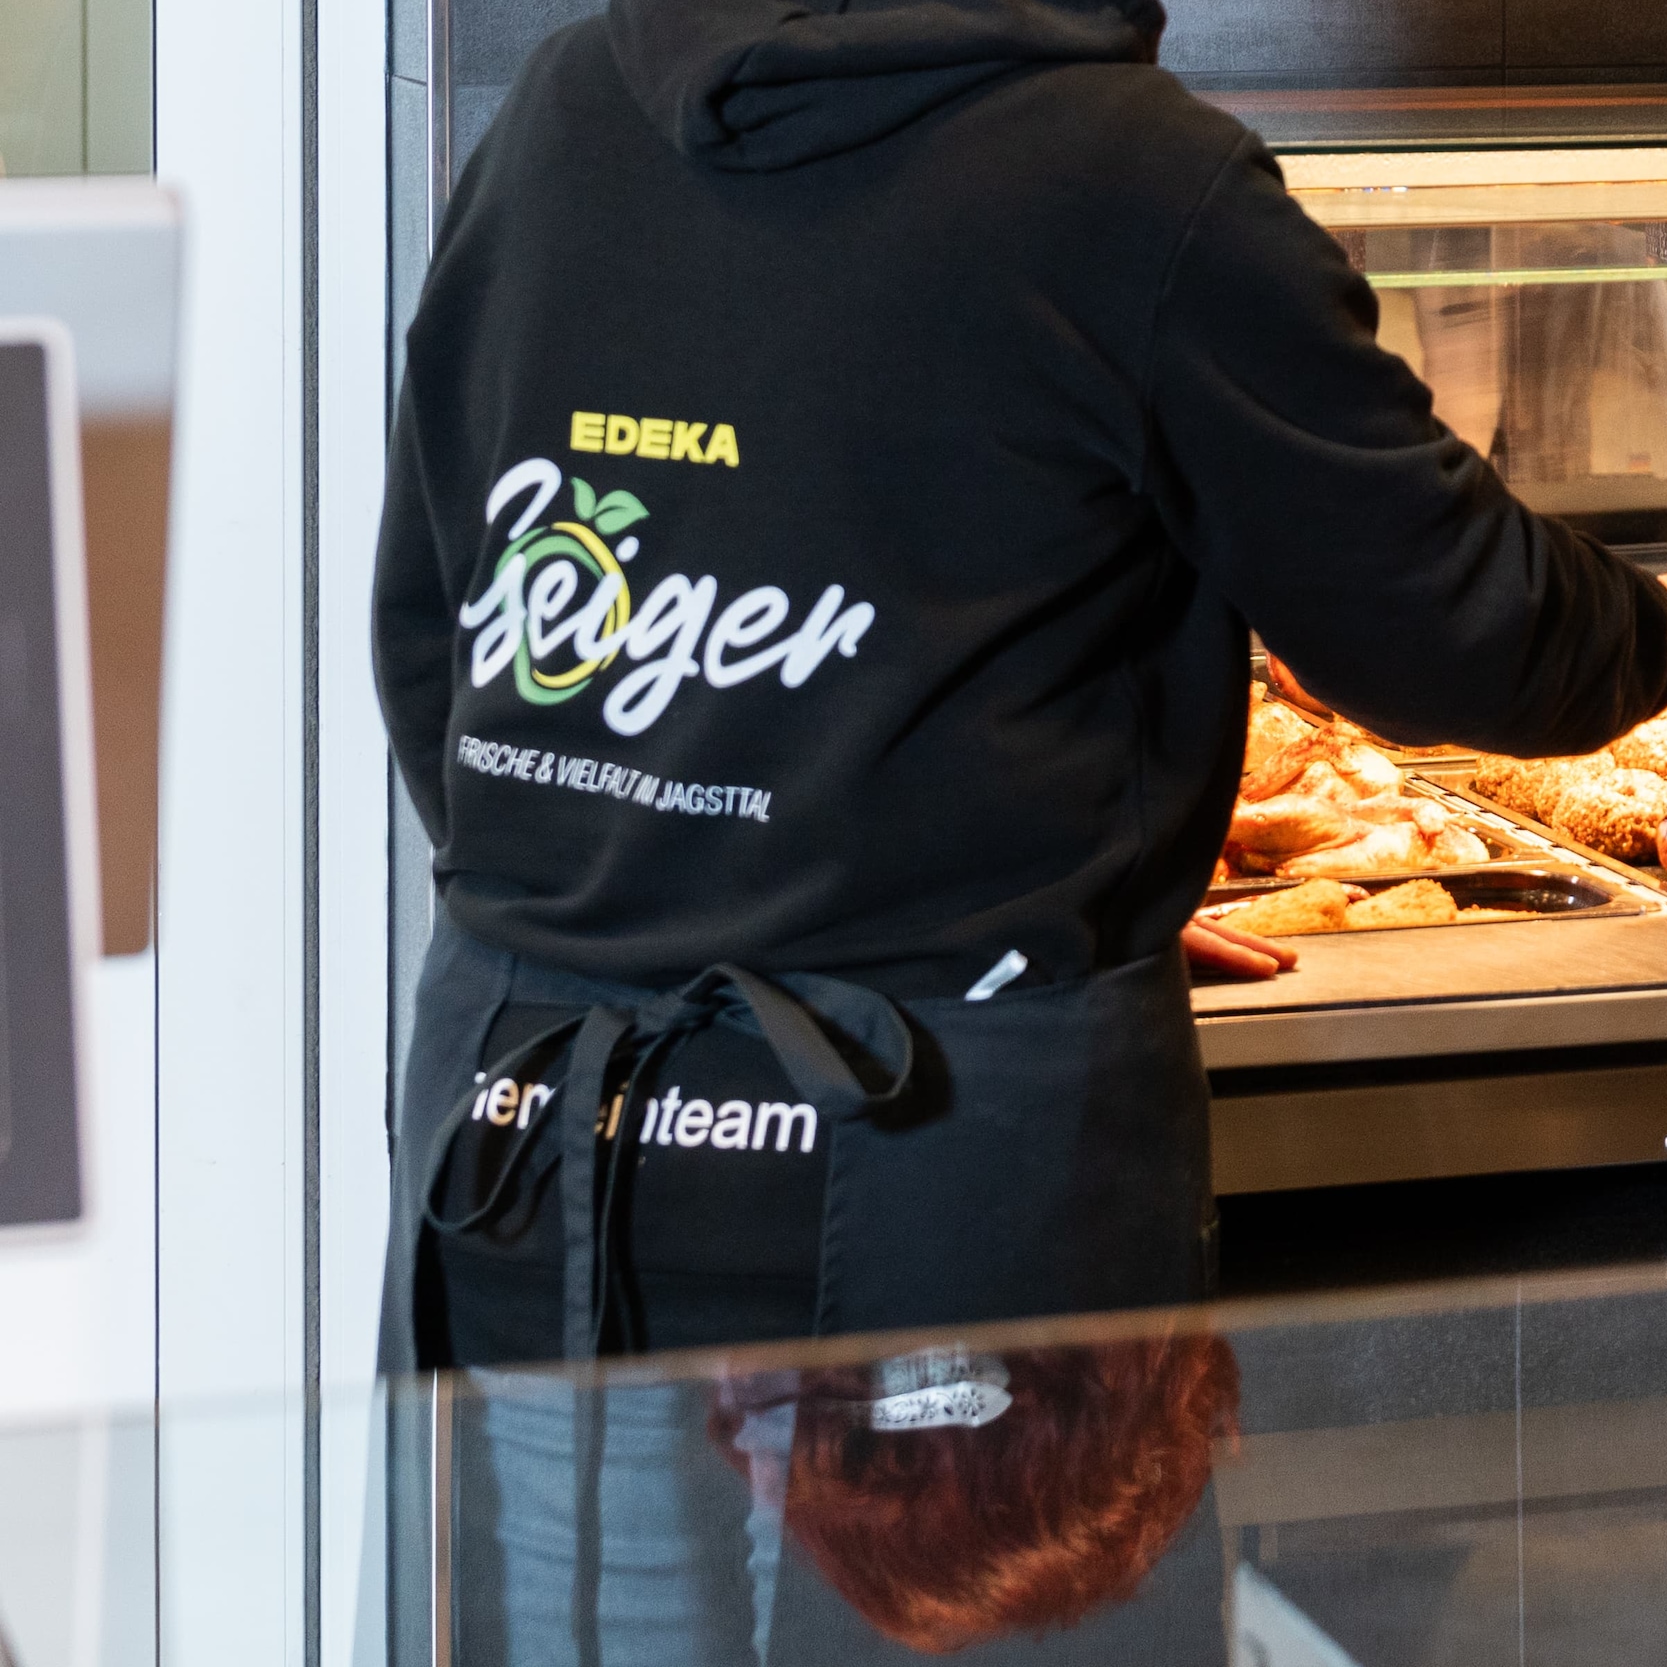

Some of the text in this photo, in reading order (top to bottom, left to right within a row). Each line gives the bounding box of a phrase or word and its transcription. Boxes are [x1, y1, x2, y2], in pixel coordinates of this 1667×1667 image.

[570, 411, 740, 468] EDEKA
[457, 735, 541, 782] FRISCHE
[534, 751, 556, 783] &
[555, 755, 642, 800] VIELFALT
[655, 781, 772, 823] JAGSTTAL
